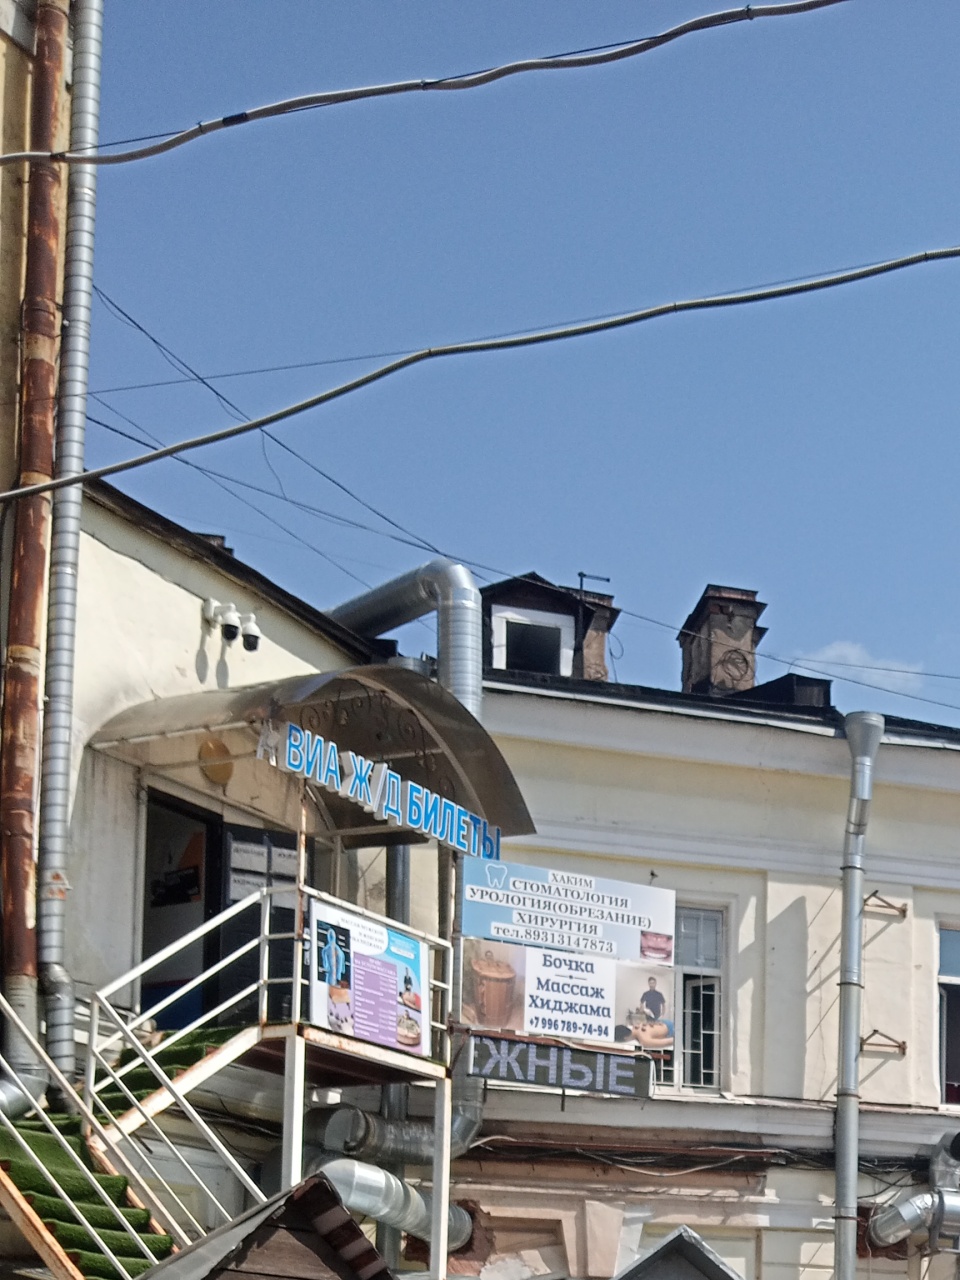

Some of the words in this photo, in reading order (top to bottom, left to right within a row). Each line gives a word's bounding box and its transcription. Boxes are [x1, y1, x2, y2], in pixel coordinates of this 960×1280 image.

[408, 783, 502, 860] БИЛЕТЫ
[551, 872, 593, 888] ХАКИМ
[511, 878, 628, 908] СТОМАТОЛОГИЯ
[516, 912, 598, 935] ХИРУРГИЯ
[542, 954, 595, 974] Бочка
[536, 977, 605, 999] Массаж
[528, 995, 612, 1018] Хиджама
[529, 1017, 539, 1028] +7
[541, 1018, 559, 1031] 996
[563, 1019, 609, 1037] 789-74-94
